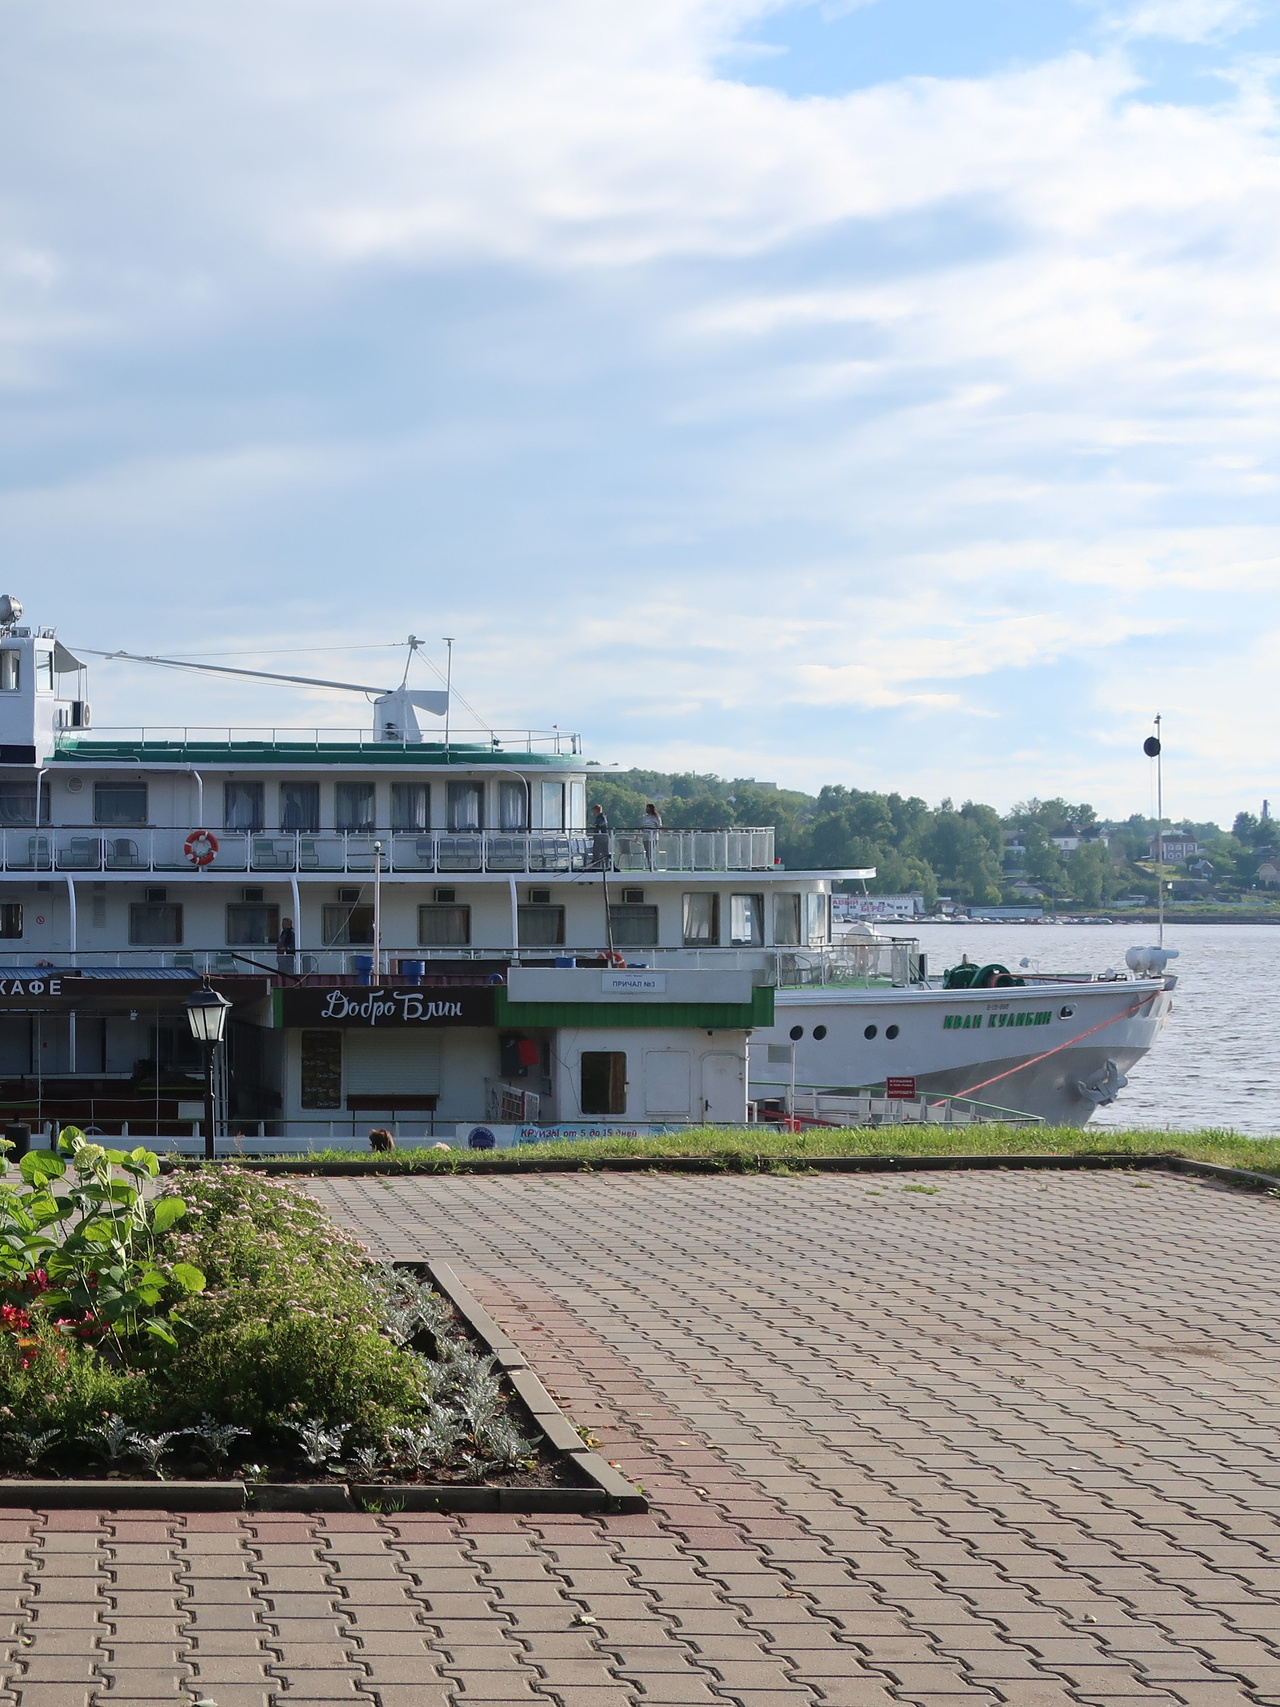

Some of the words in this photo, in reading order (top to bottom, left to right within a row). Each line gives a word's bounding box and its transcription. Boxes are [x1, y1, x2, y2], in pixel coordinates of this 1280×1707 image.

[321, 990, 396, 1026] Добро
[393, 991, 463, 1021] Блин
[943, 1014, 983, 1030] ИВАН
[987, 1010, 1052, 1029] КУЛИБИН
[563, 1130, 577, 1138] от
[580, 1128, 587, 1137] 5
[589, 1128, 601, 1137] до
[603, 1128, 613, 1137] 15
